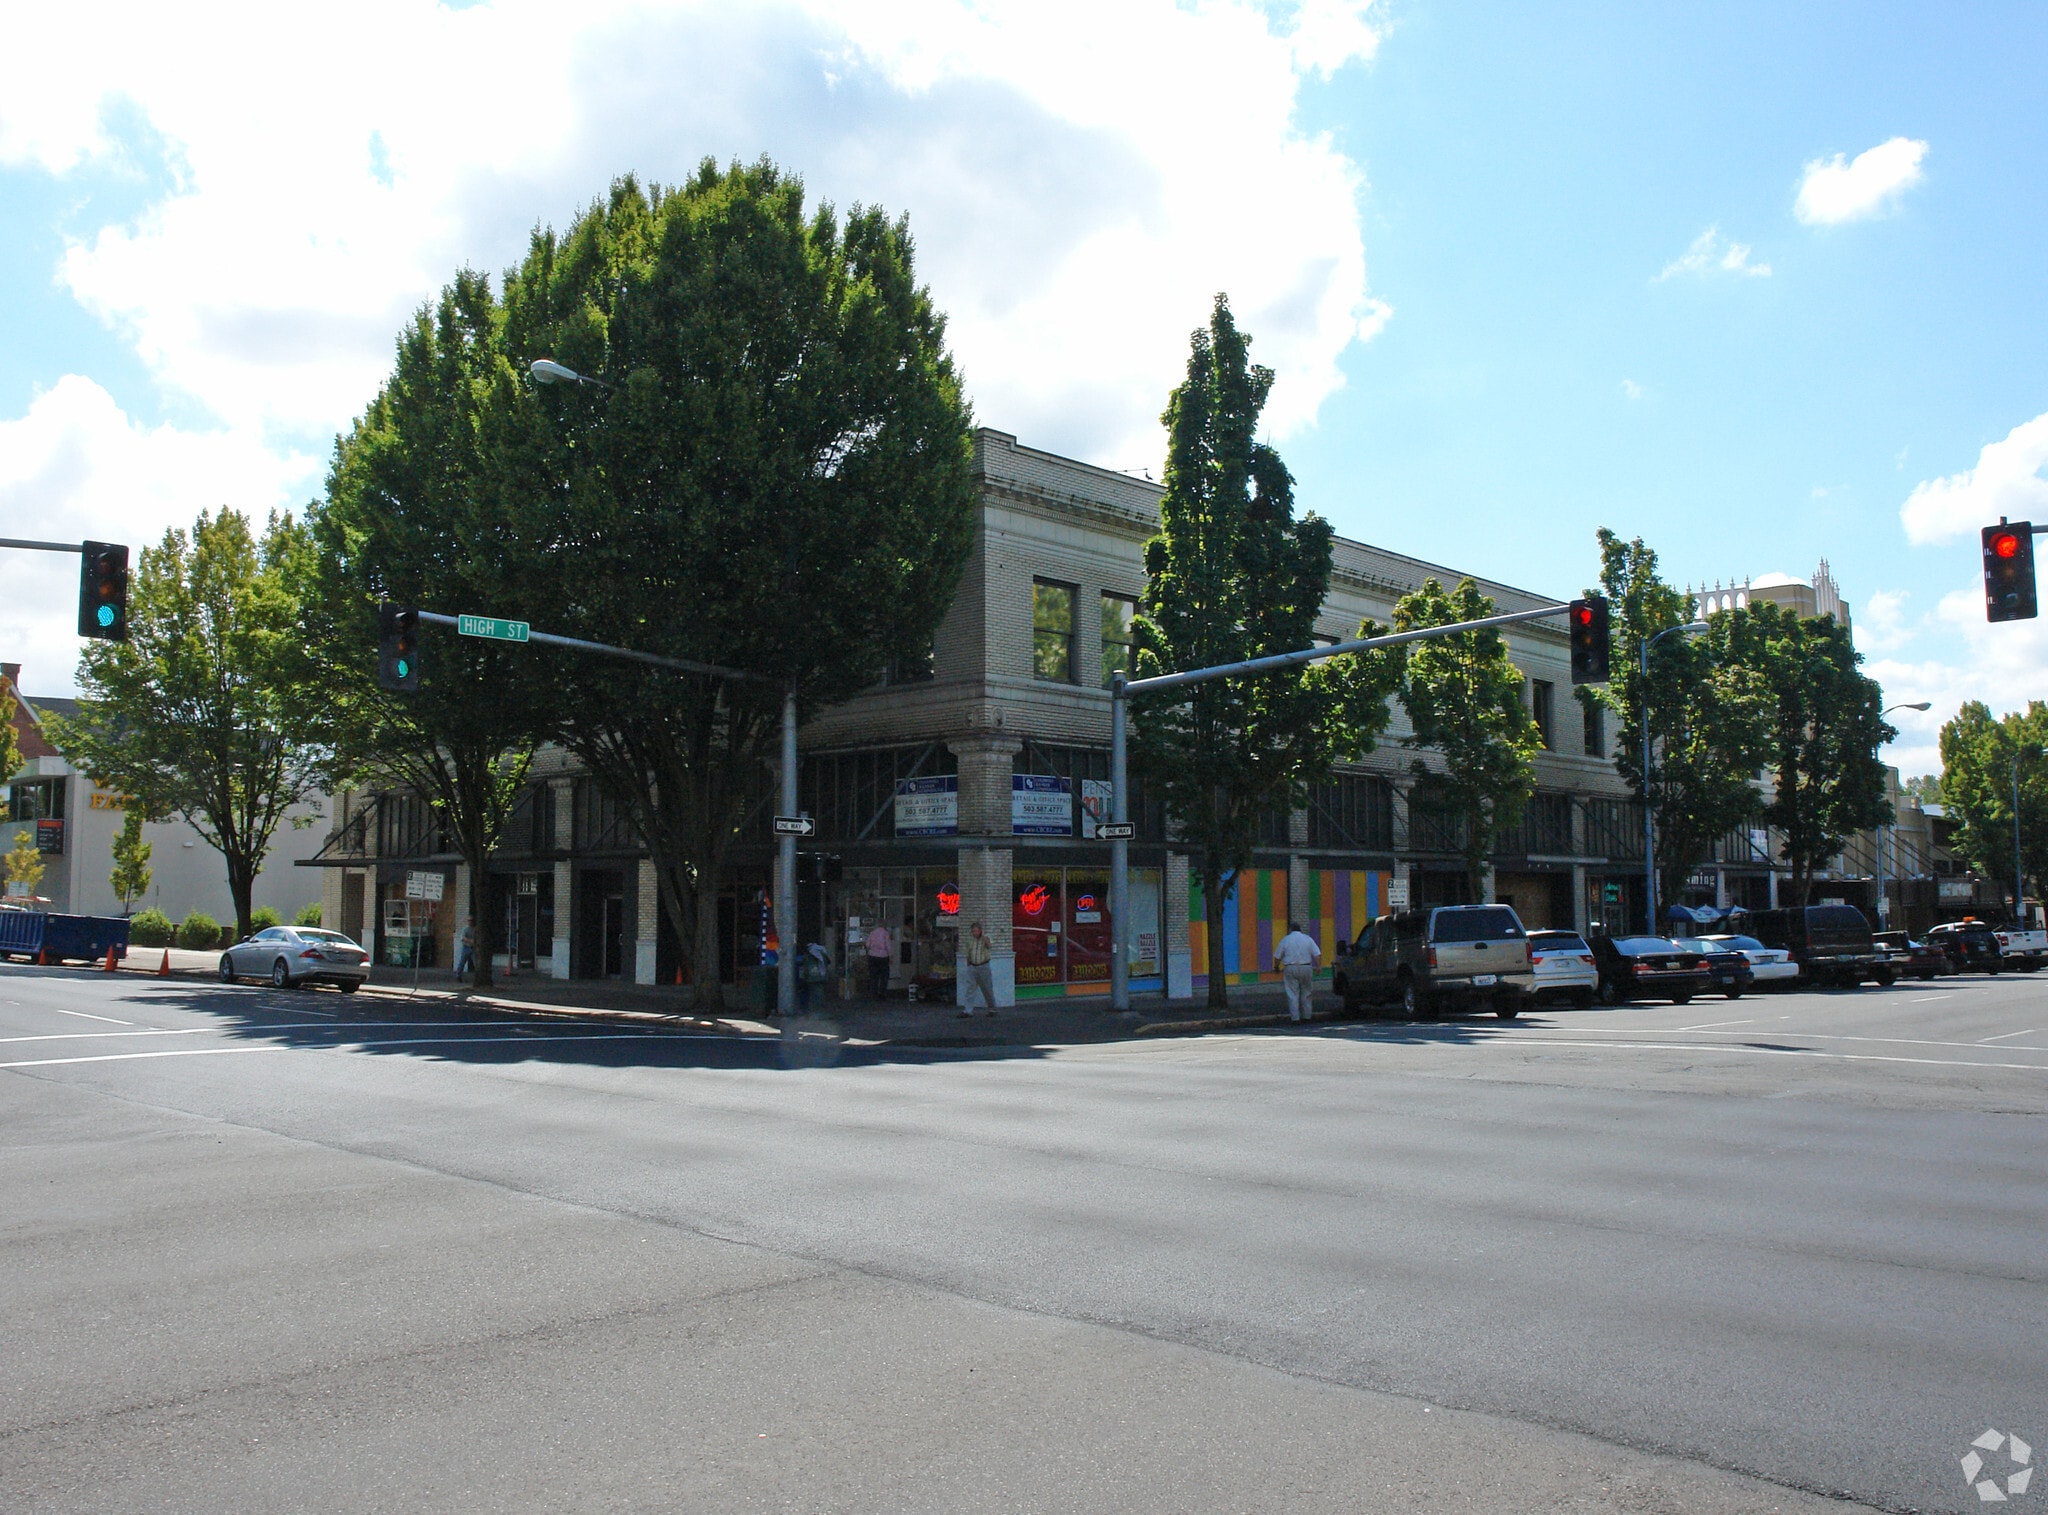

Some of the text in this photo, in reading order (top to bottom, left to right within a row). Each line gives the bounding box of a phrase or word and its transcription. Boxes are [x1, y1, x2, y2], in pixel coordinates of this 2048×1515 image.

[464, 618, 523, 638] HIGH ST
[1077, 897, 1095, 908] OPEN
